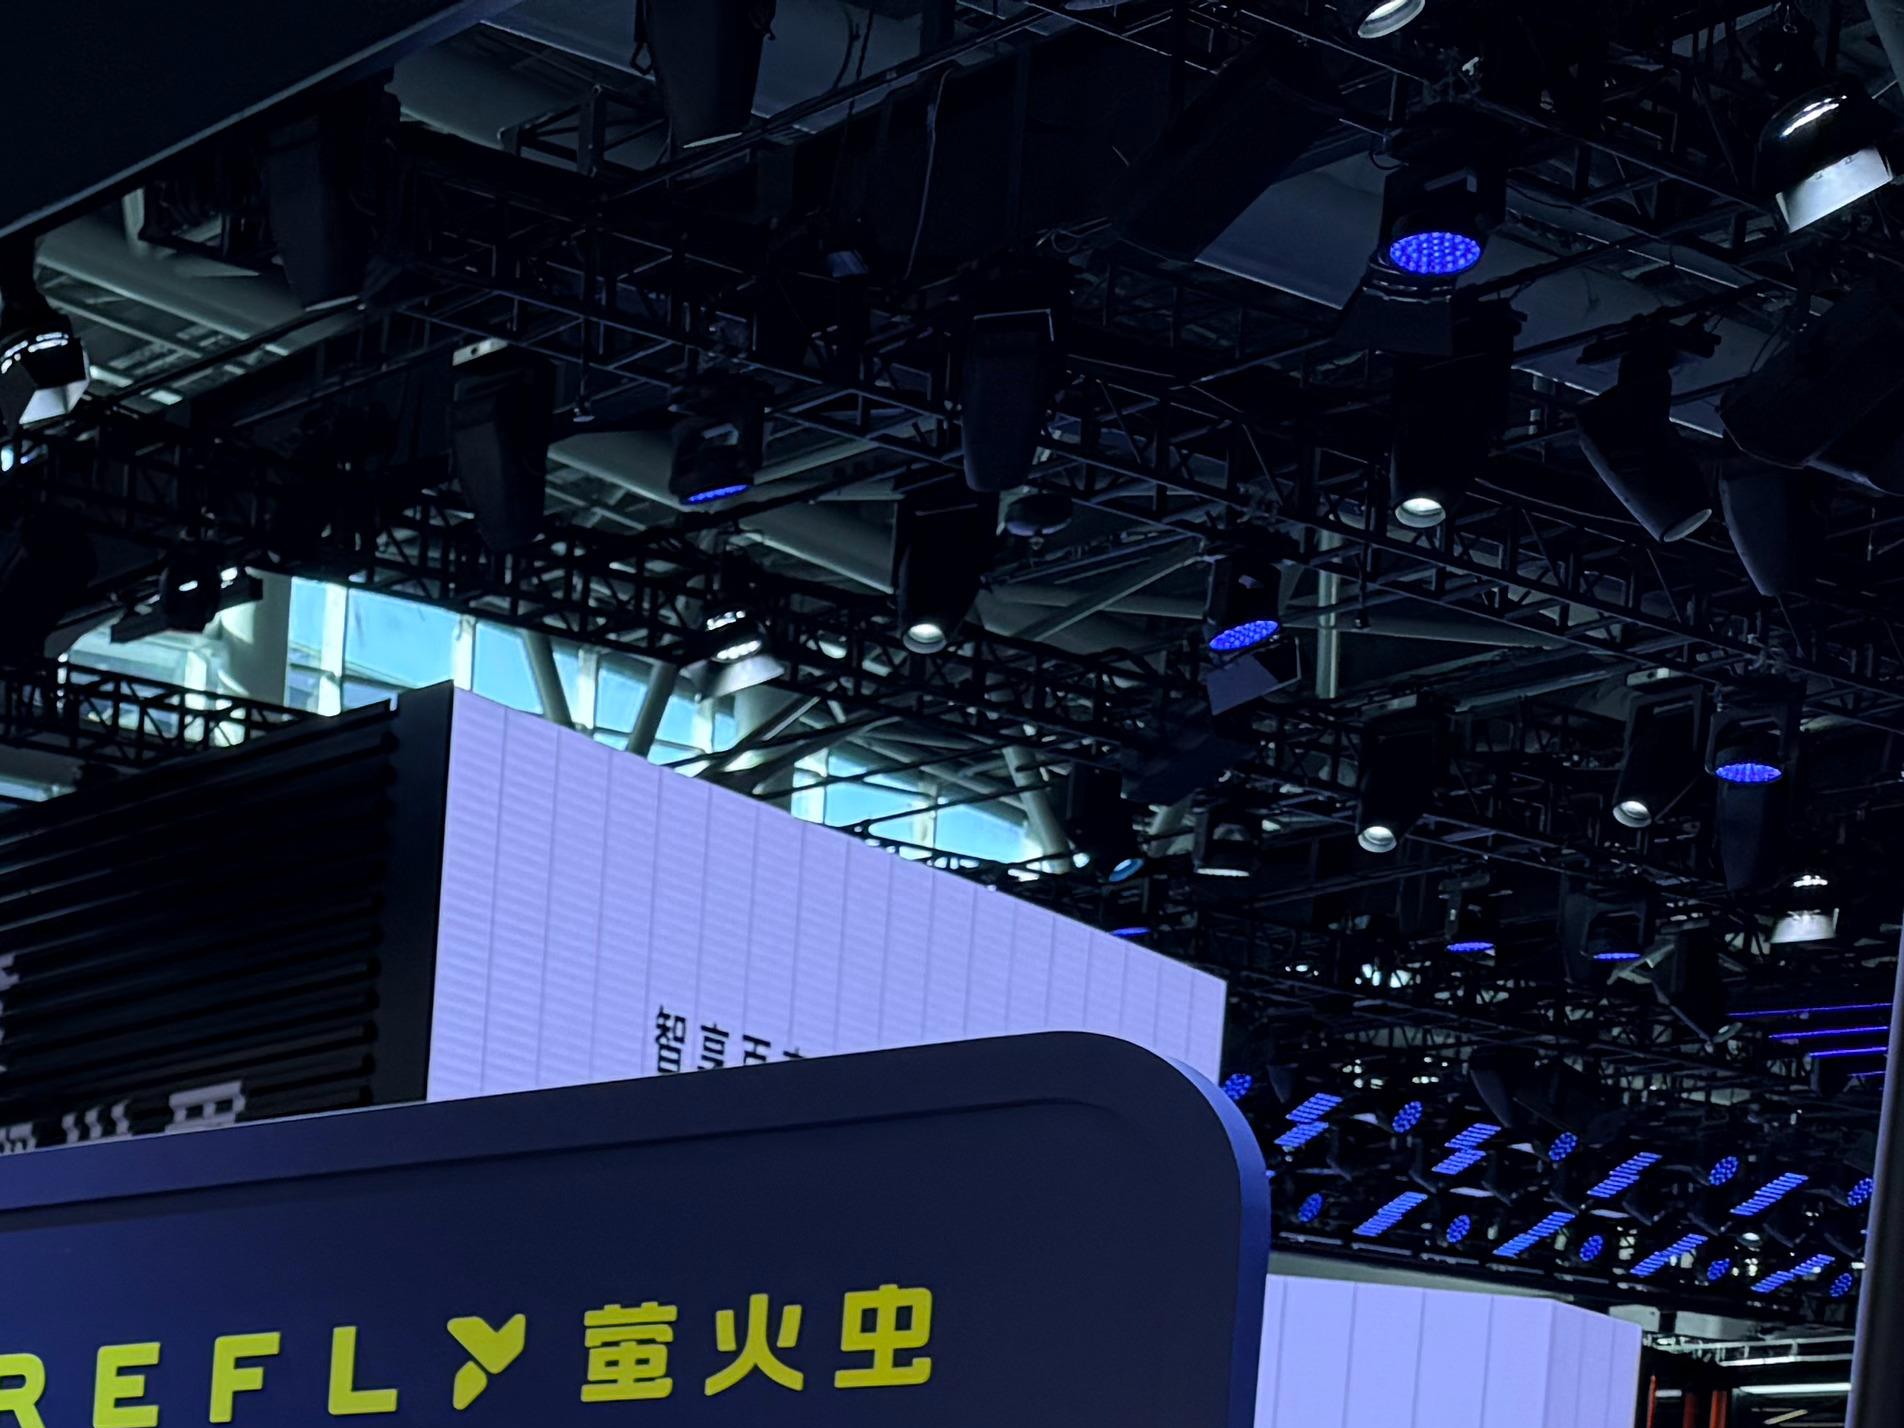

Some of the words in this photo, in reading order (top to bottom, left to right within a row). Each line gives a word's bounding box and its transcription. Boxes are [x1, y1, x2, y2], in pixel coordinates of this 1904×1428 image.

[654, 1004, 806, 1073] 智享
[581, 1284, 934, 1403] 萤火虫
